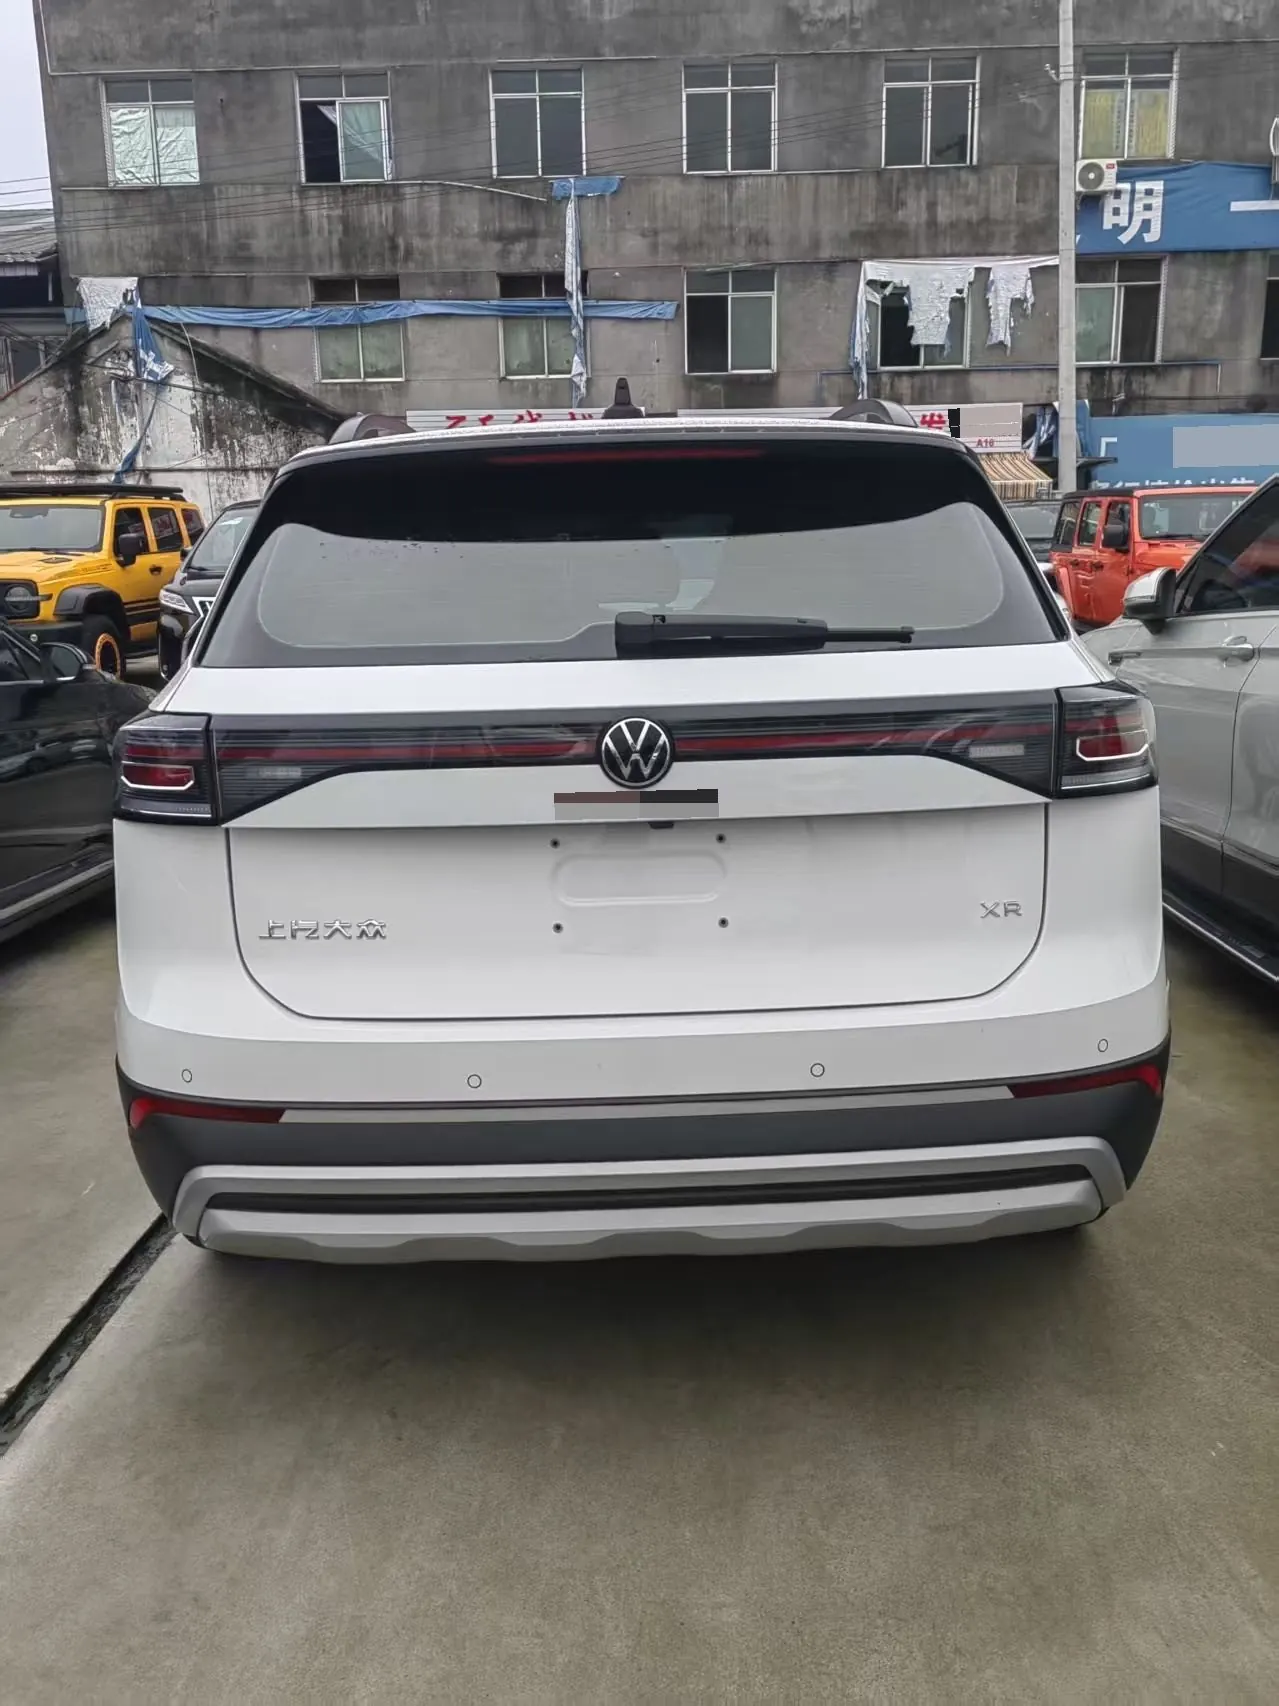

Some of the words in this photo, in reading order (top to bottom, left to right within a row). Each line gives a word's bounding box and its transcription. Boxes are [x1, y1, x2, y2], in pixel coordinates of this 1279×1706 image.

[980, 900, 1022, 918] XR
[259, 919, 387, 940] 上汽大众
